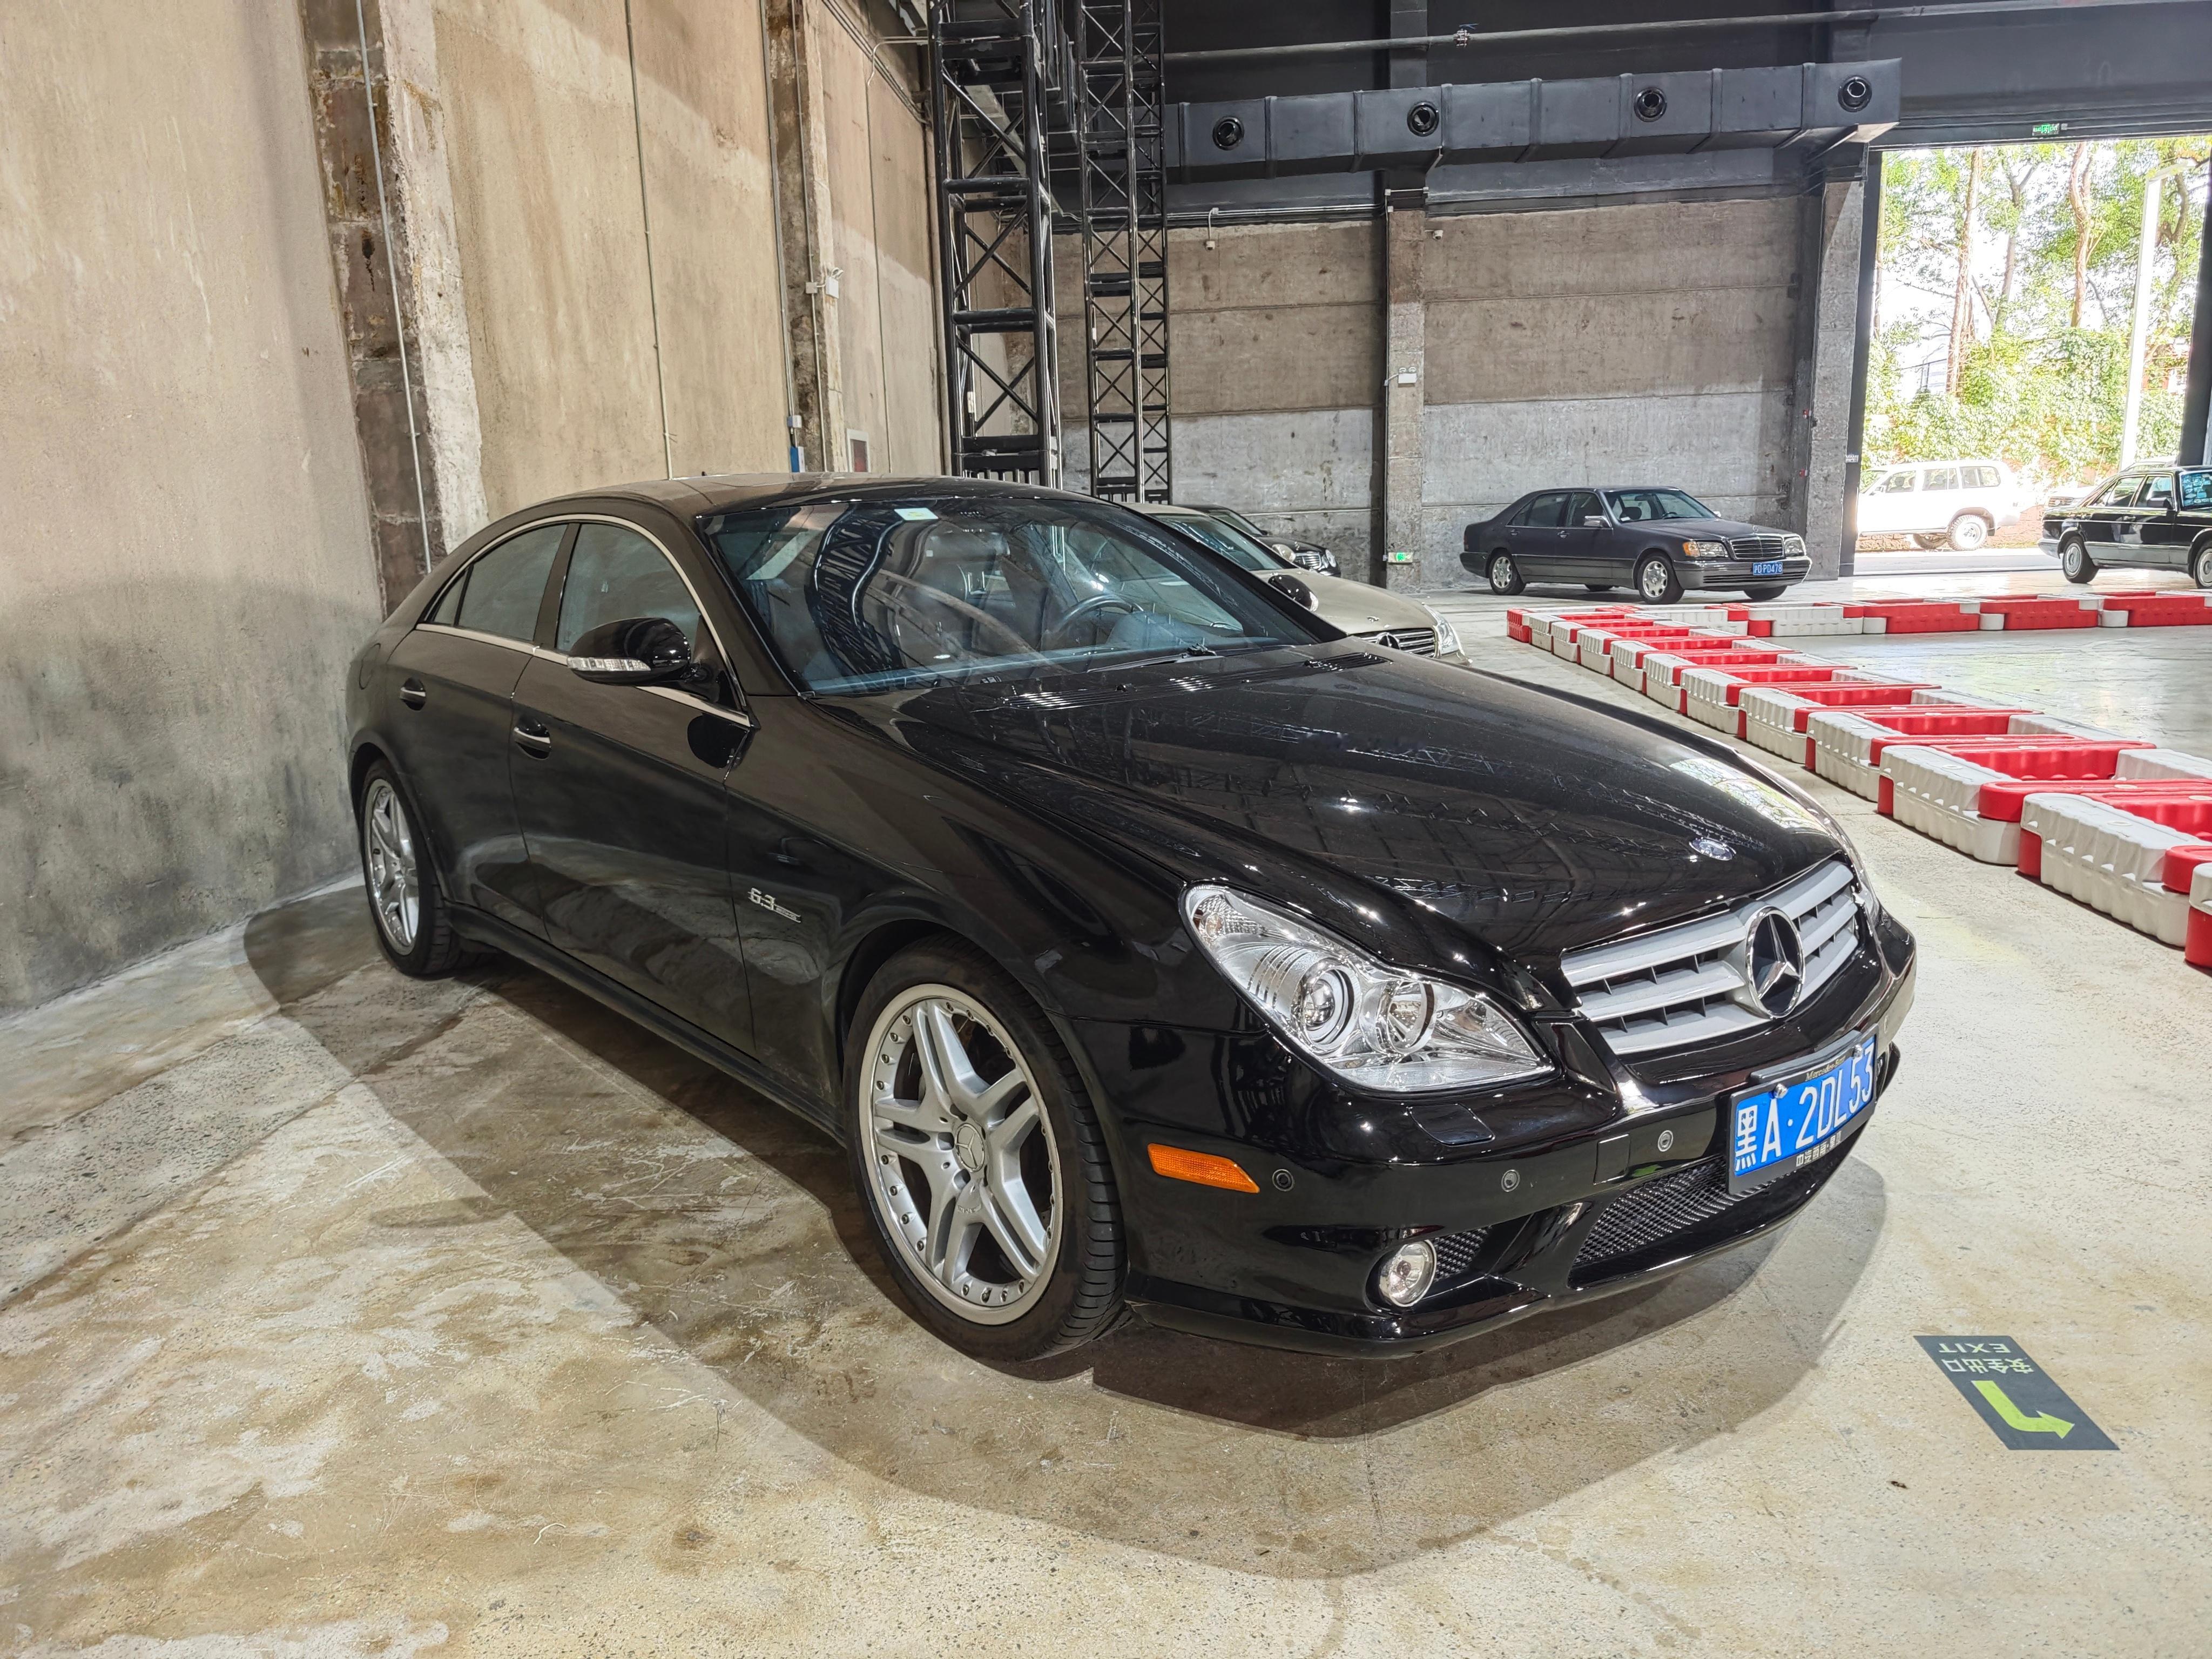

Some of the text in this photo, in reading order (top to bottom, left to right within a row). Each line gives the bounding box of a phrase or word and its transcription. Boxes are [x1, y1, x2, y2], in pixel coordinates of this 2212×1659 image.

[1938, 1343, 2011, 1353] EXIT
[1942, 1357, 2035, 1374] 安全出口
